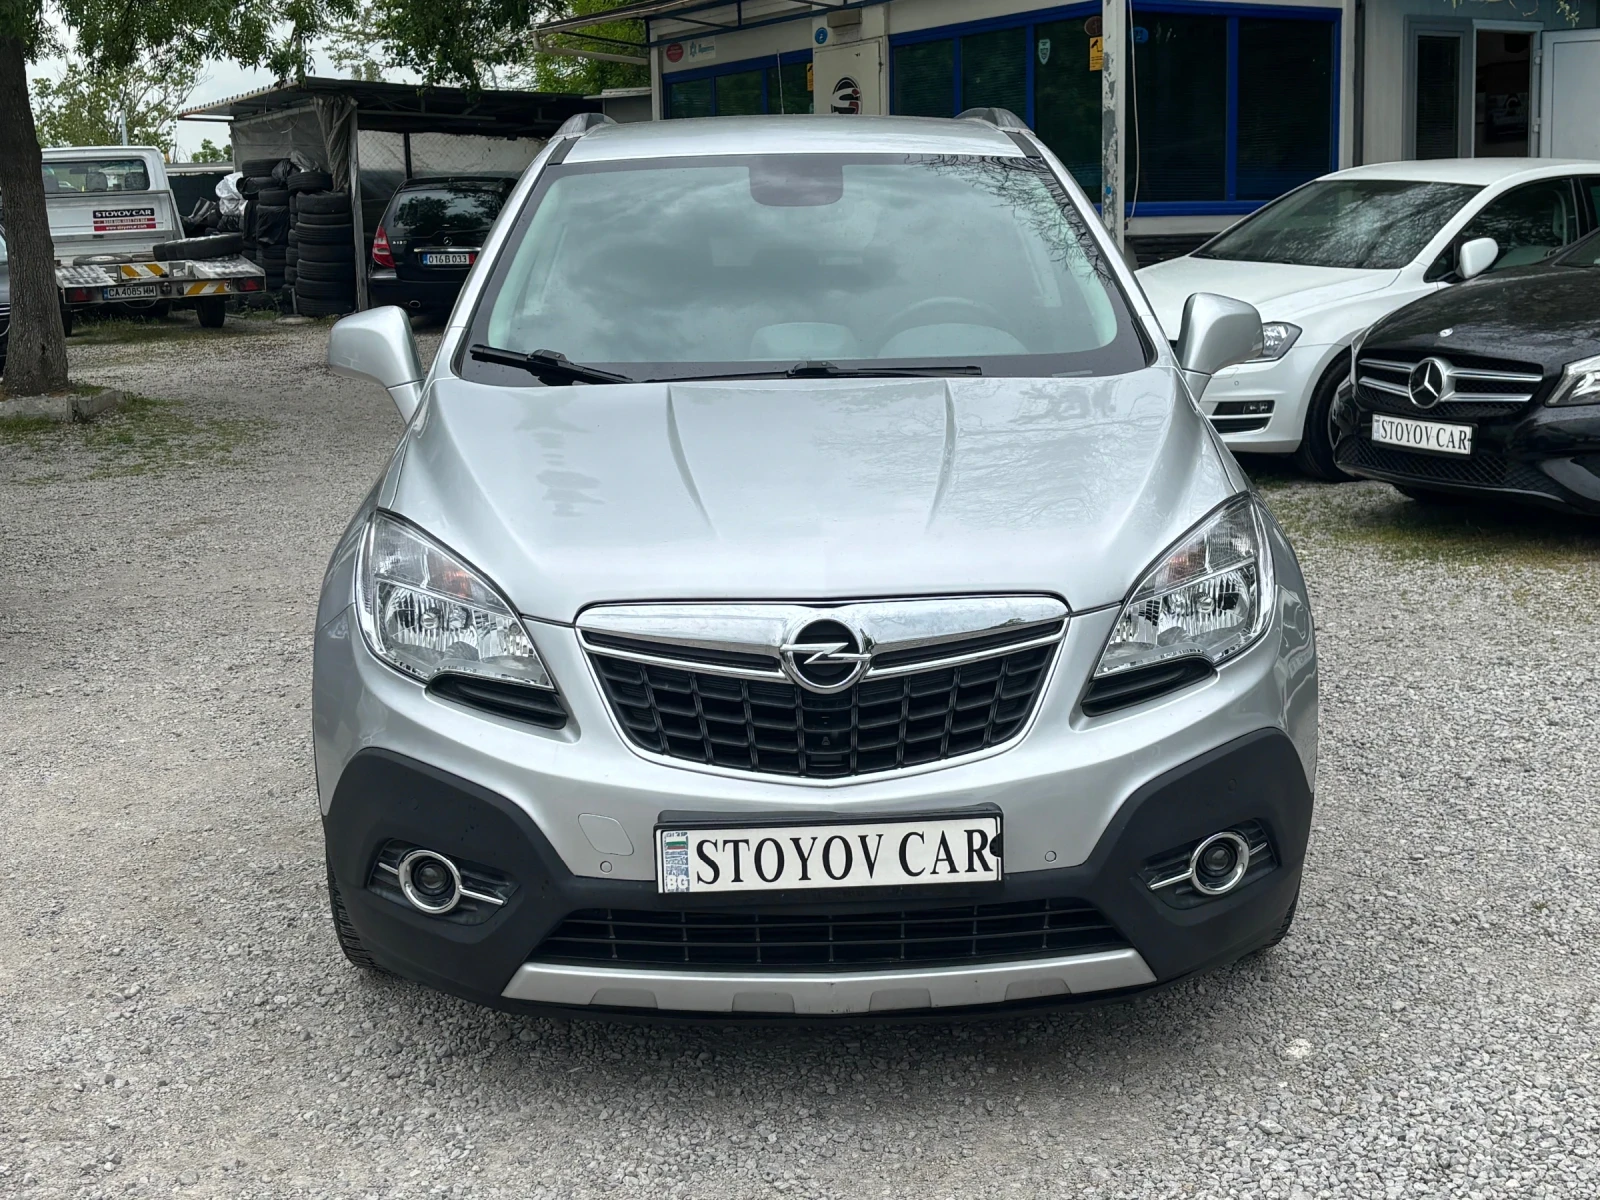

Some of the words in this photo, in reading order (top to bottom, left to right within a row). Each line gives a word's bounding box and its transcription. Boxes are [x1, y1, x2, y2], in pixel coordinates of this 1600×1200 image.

[95, 210, 131, 218] STOYOV
[1381, 419, 1433, 446] STOYOV
[1436, 427, 1467, 451] CAR
[696, 833, 884, 885] STOYOV
[898, 829, 994, 877] CAR
